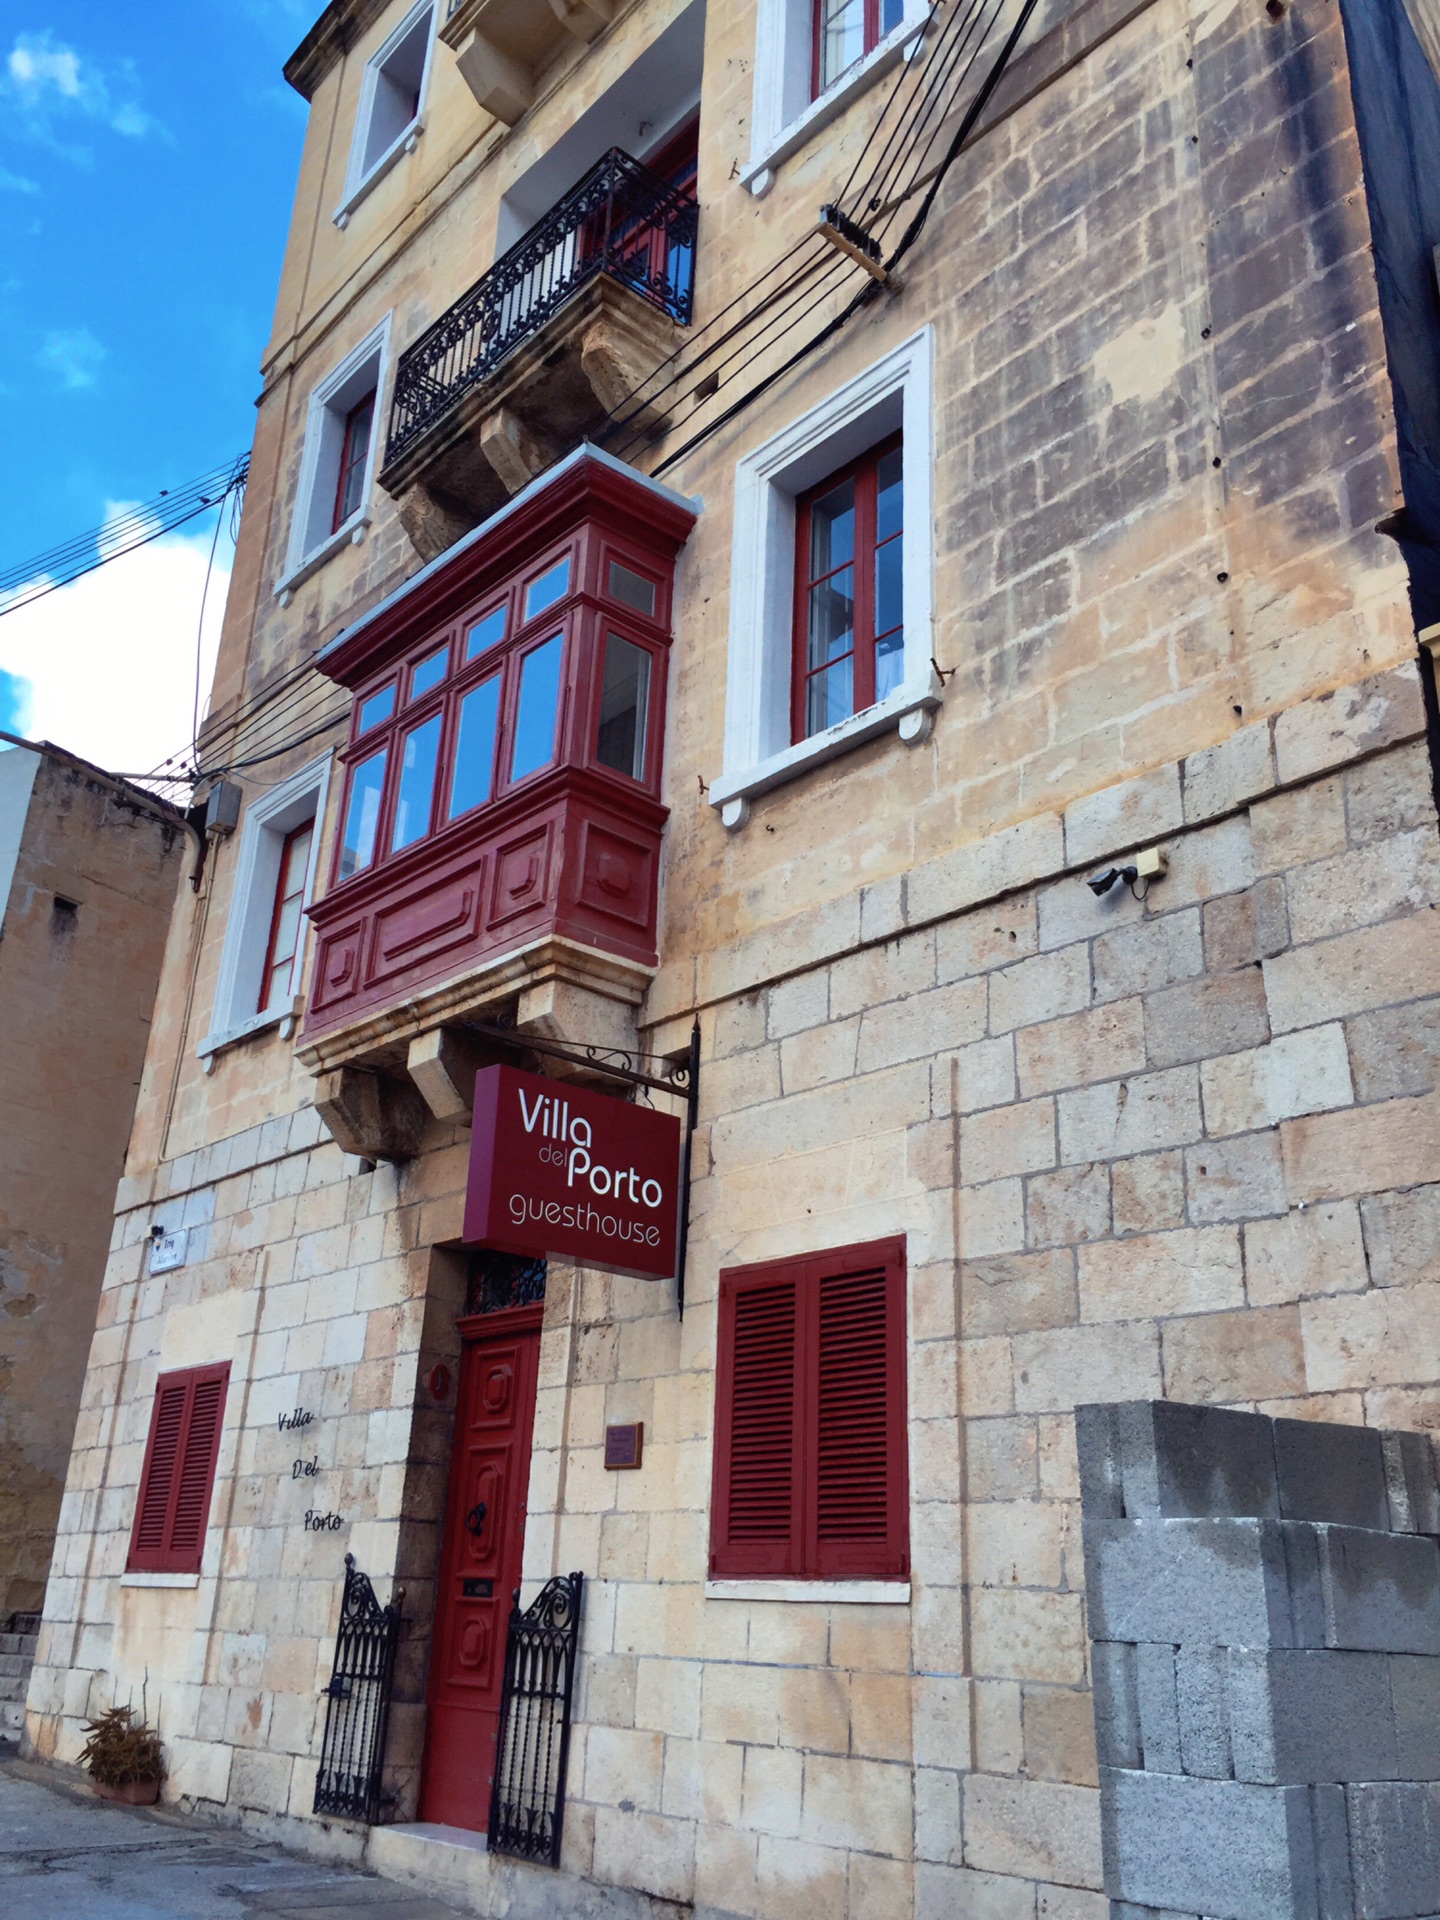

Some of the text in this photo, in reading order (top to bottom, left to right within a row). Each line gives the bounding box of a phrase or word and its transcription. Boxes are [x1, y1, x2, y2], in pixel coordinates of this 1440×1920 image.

[519, 1088, 592, 1148] Villa
[538, 1143, 662, 1208] del Porto
[509, 1193, 660, 1246] guesthouse
[278, 1407, 316, 1432] Villa
[292, 1455, 323, 1480] Del
[304, 1509, 345, 1532] Porto
